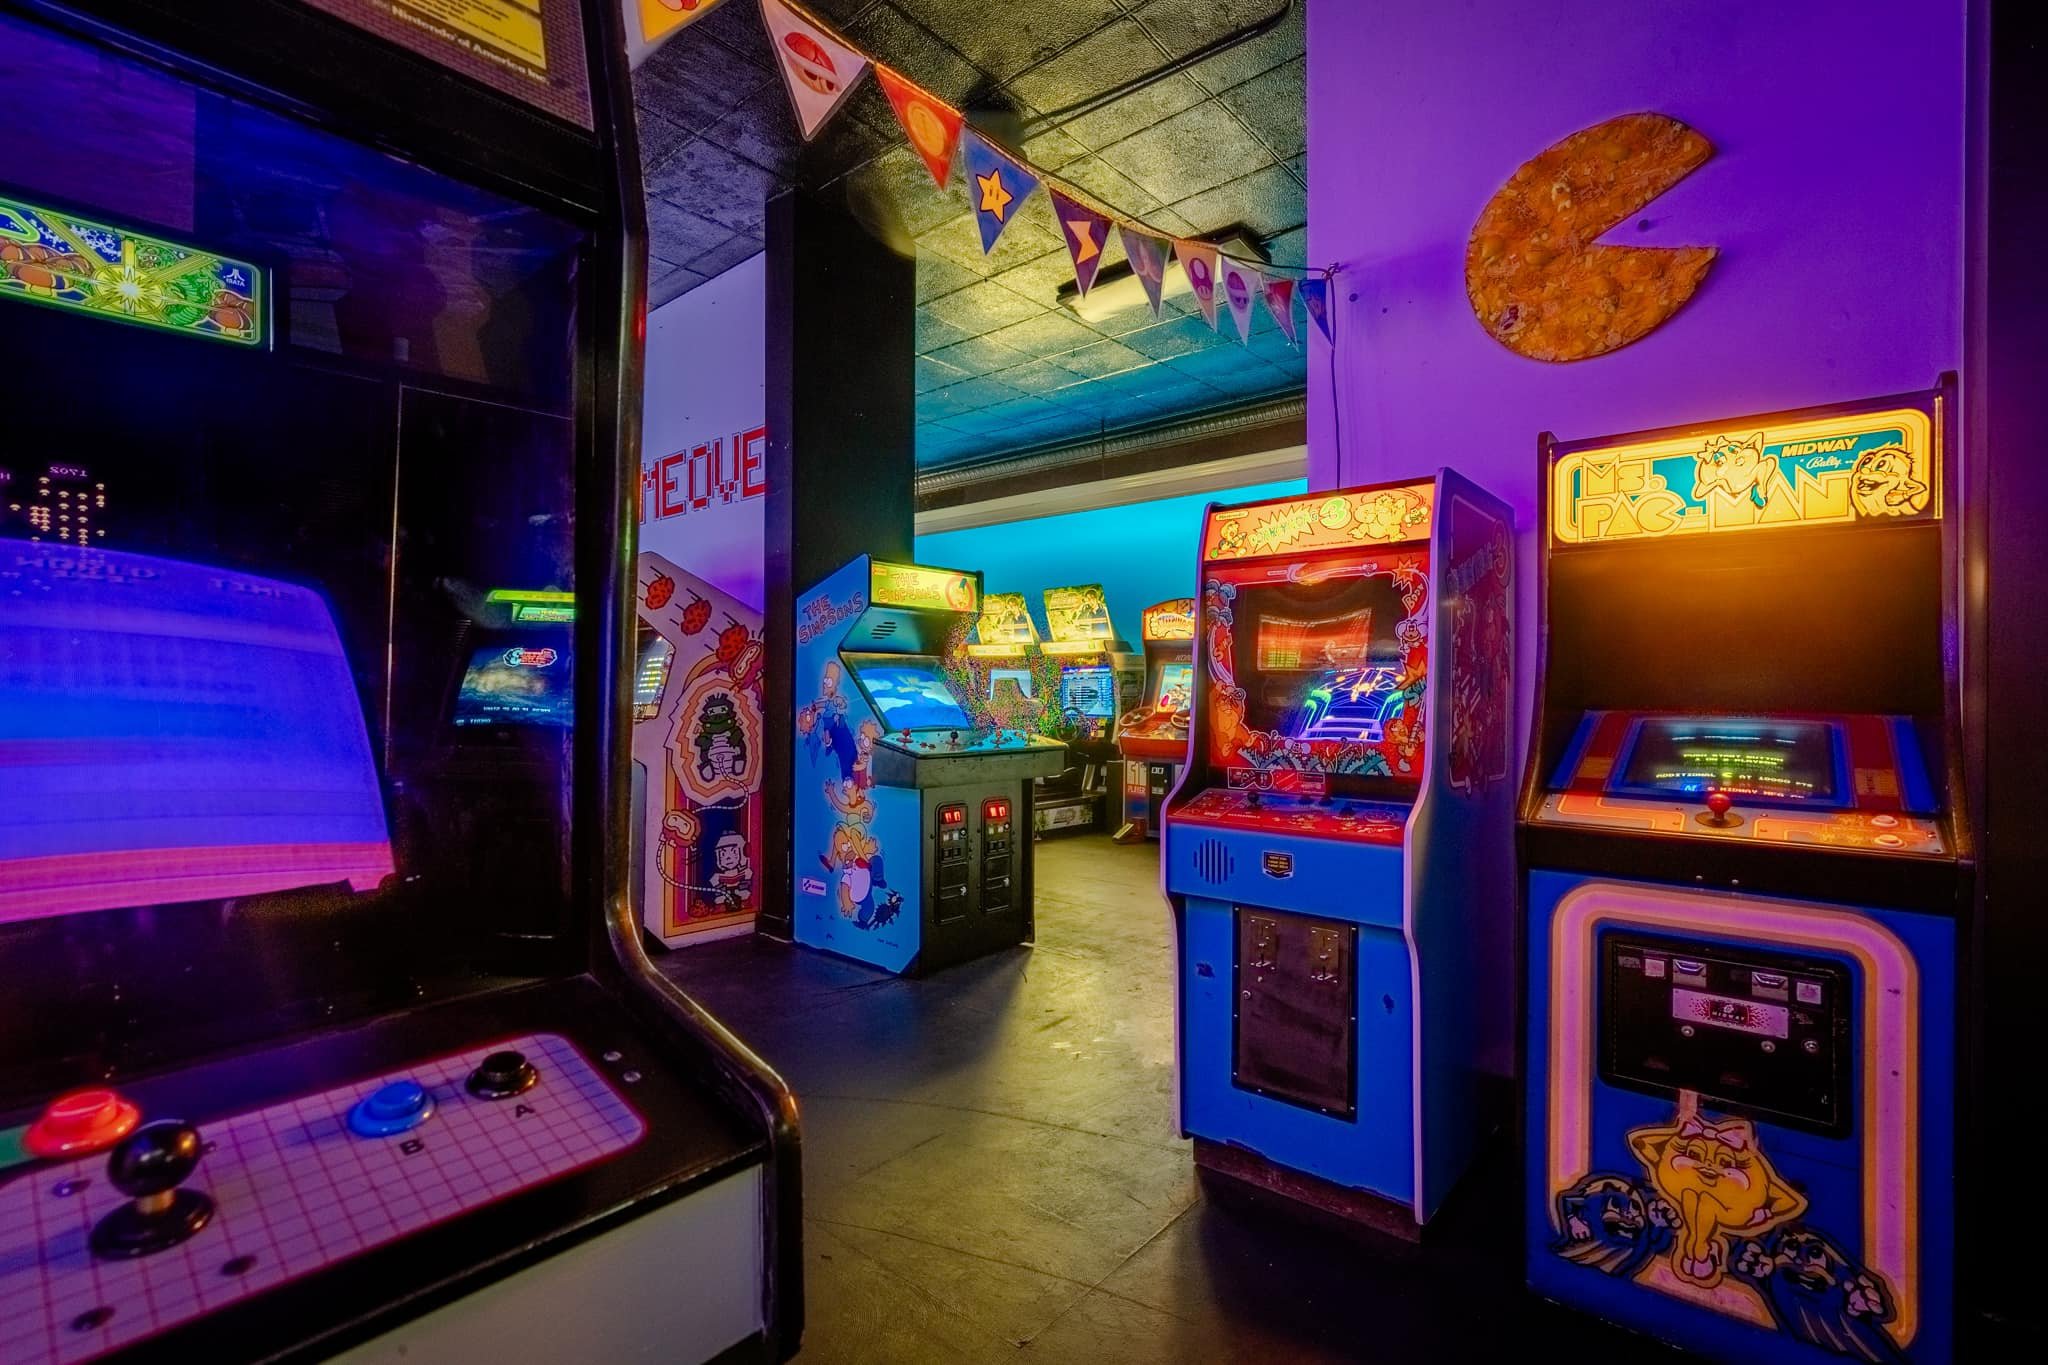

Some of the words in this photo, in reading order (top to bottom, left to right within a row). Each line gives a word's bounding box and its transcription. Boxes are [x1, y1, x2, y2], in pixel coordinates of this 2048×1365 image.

[1781, 437, 1859, 457] MIDWAY
[1806, 456, 1841, 469] Bally
[1578, 464, 1855, 542] PAC-MAN
[892, 572, 919, 588] THE
[878, 585, 942, 601] SIMPSONS
[803, 594, 832, 621] THE
[799, 592, 864, 644] SIMPSONS
[514, 1104, 536, 1118] A
[399, 1138, 425, 1156] B
